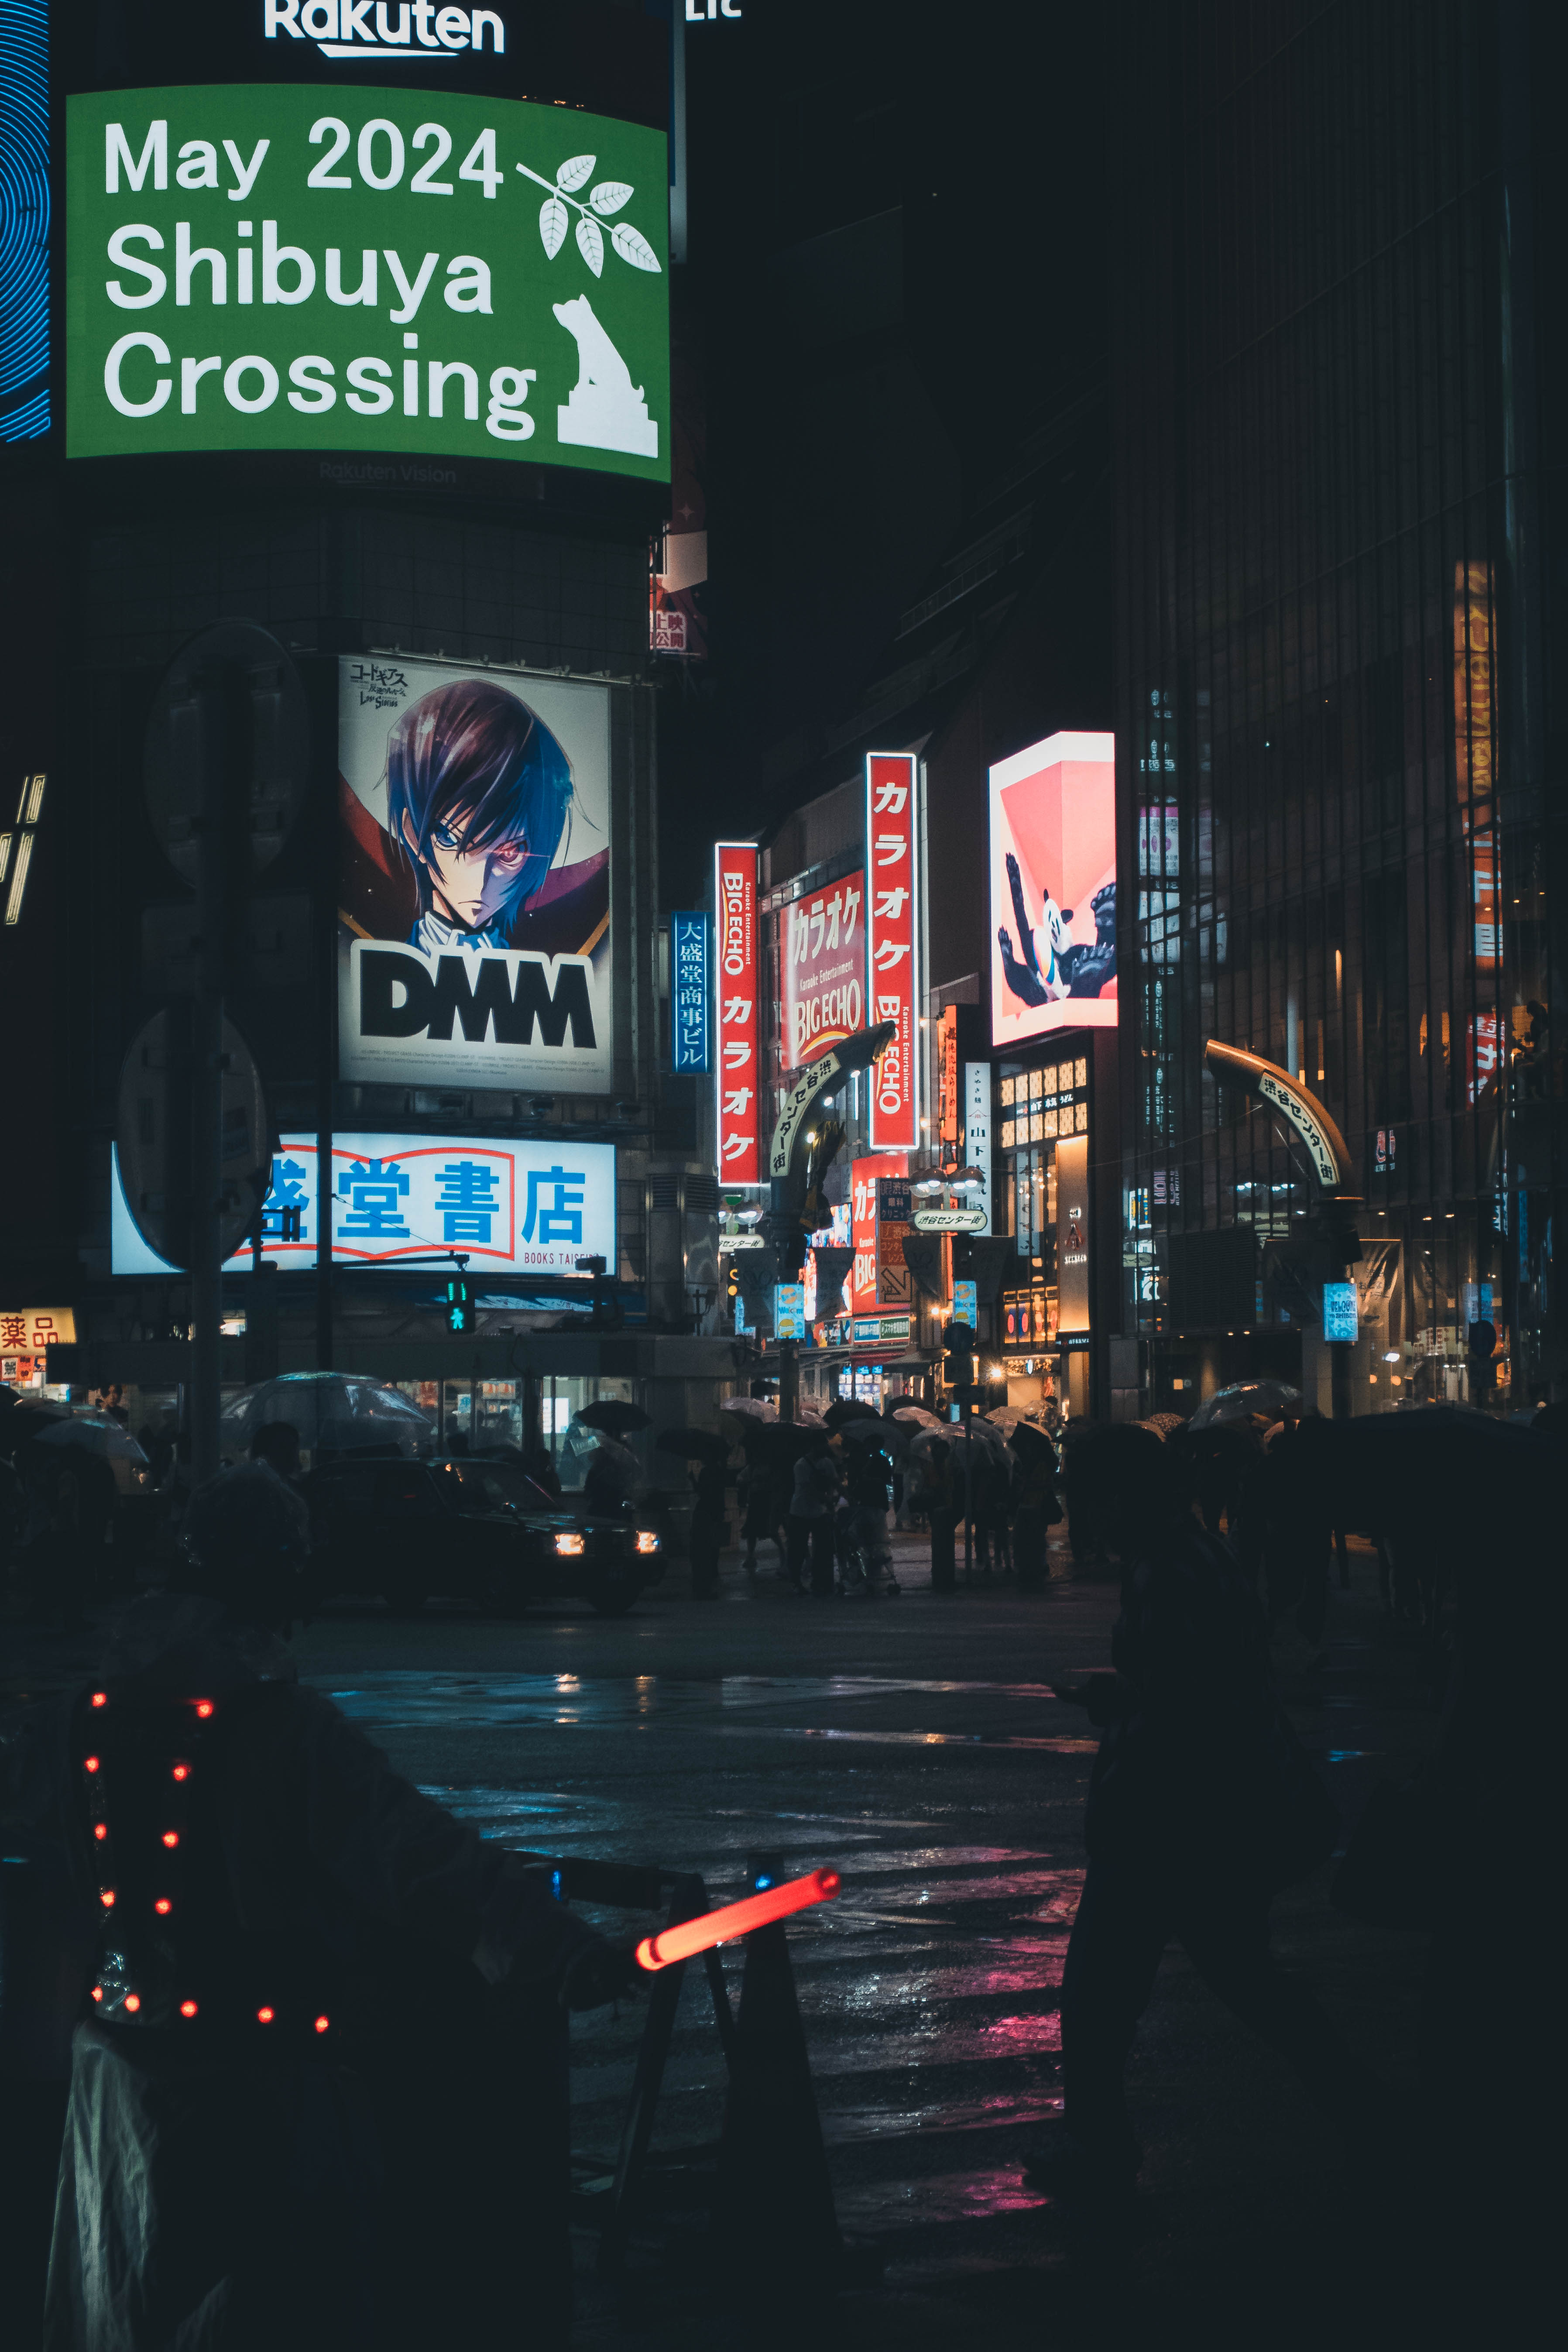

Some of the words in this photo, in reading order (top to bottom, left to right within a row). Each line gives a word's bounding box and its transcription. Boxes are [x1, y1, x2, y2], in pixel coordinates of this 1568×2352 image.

[264, 0, 504, 53] Rakuten
[105, 119, 270, 201] May
[307, 116, 504, 199] 2024
[105, 220, 494, 324] Shibuya
[103, 332, 537, 442] Crossing
[350, 663, 408, 687] コードギアス
[724, 873, 743, 913] BIG
[873, 783, 910, 971] カラオケ
[724, 917, 744, 975] ECHO
[794, 887, 860, 965] カラオケ
[360, 949, 597, 1049] DMM
[679, 922, 703, 1064] 大盛堂商事ビル
[799, 973, 818, 992] Karaoke
[820, 958, 854, 984] Entertainment
[795, 997, 820, 1052] BIG
[822, 979, 861, 1031] ECHO
[723, 996, 754, 1161] カラオケ
[879, 1046, 901, 1114] ECHO
[773, 1060, 831, 1173] 渋谷センター街
[1264, 1078, 1333, 1181] 渋谷センター街
[918, 1215, 982, 1225] 渋谷センター街
[525, 1253, 554, 1264] BOOKS
[1, 1316, 59, 1348] 薬品
